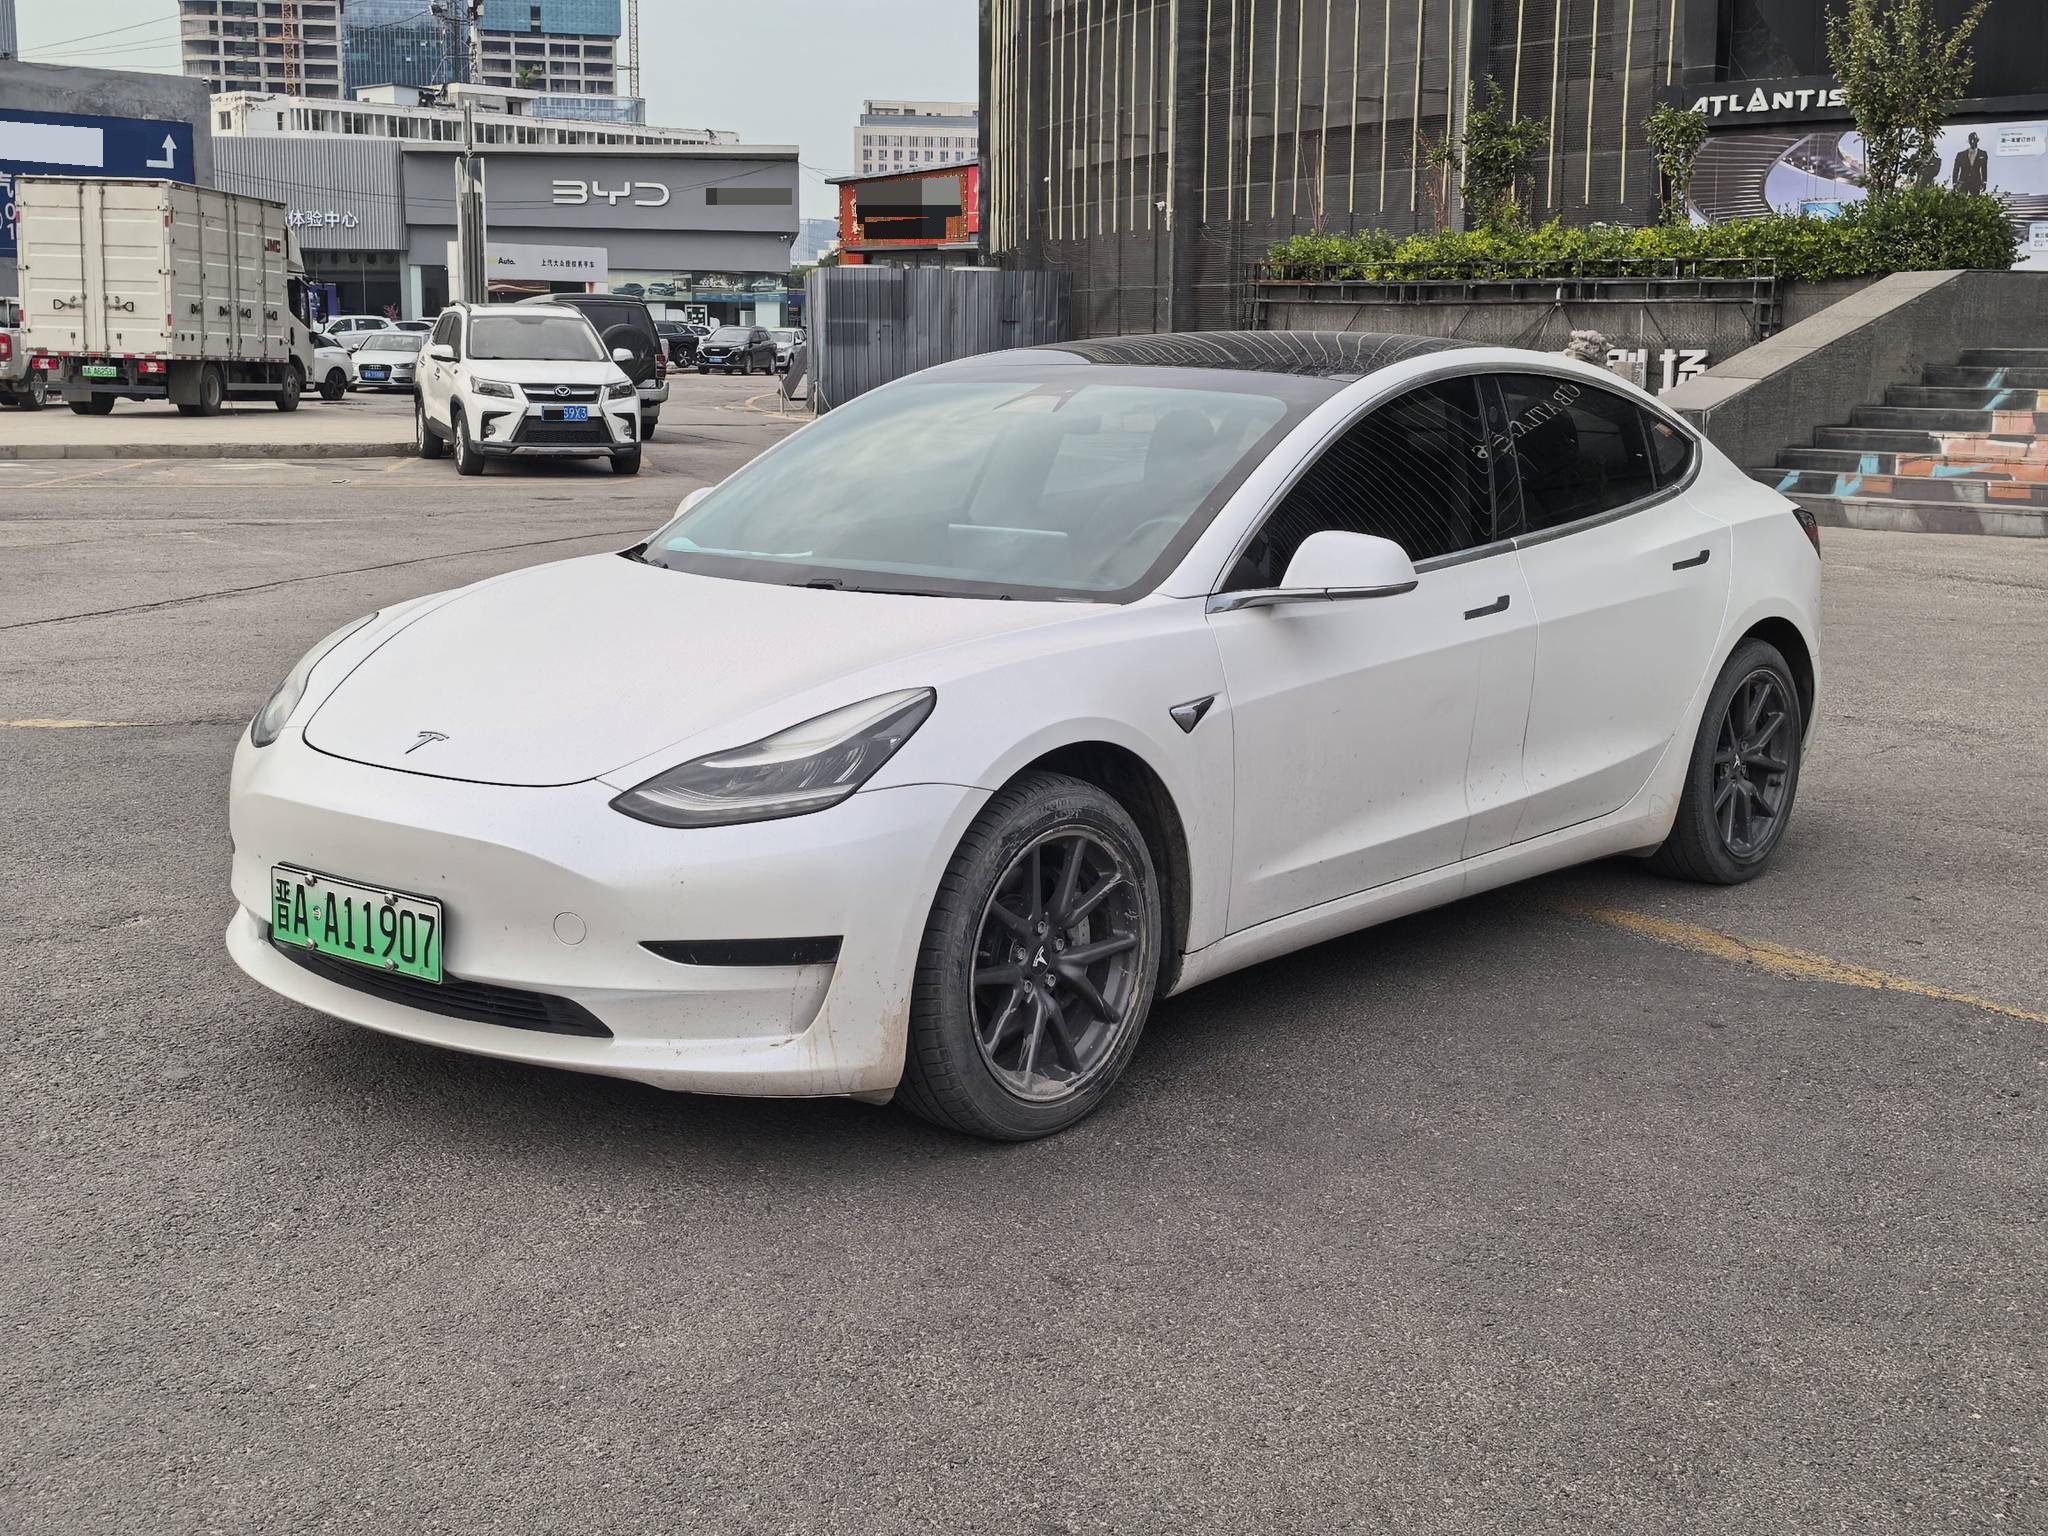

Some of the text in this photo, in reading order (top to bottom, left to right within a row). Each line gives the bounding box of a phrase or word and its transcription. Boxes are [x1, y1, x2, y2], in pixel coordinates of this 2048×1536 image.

[1690, 88, 1846, 117] ATLANTIS
[552, 180, 670, 207] BYD
[285, 208, 359, 228] 体验中心
